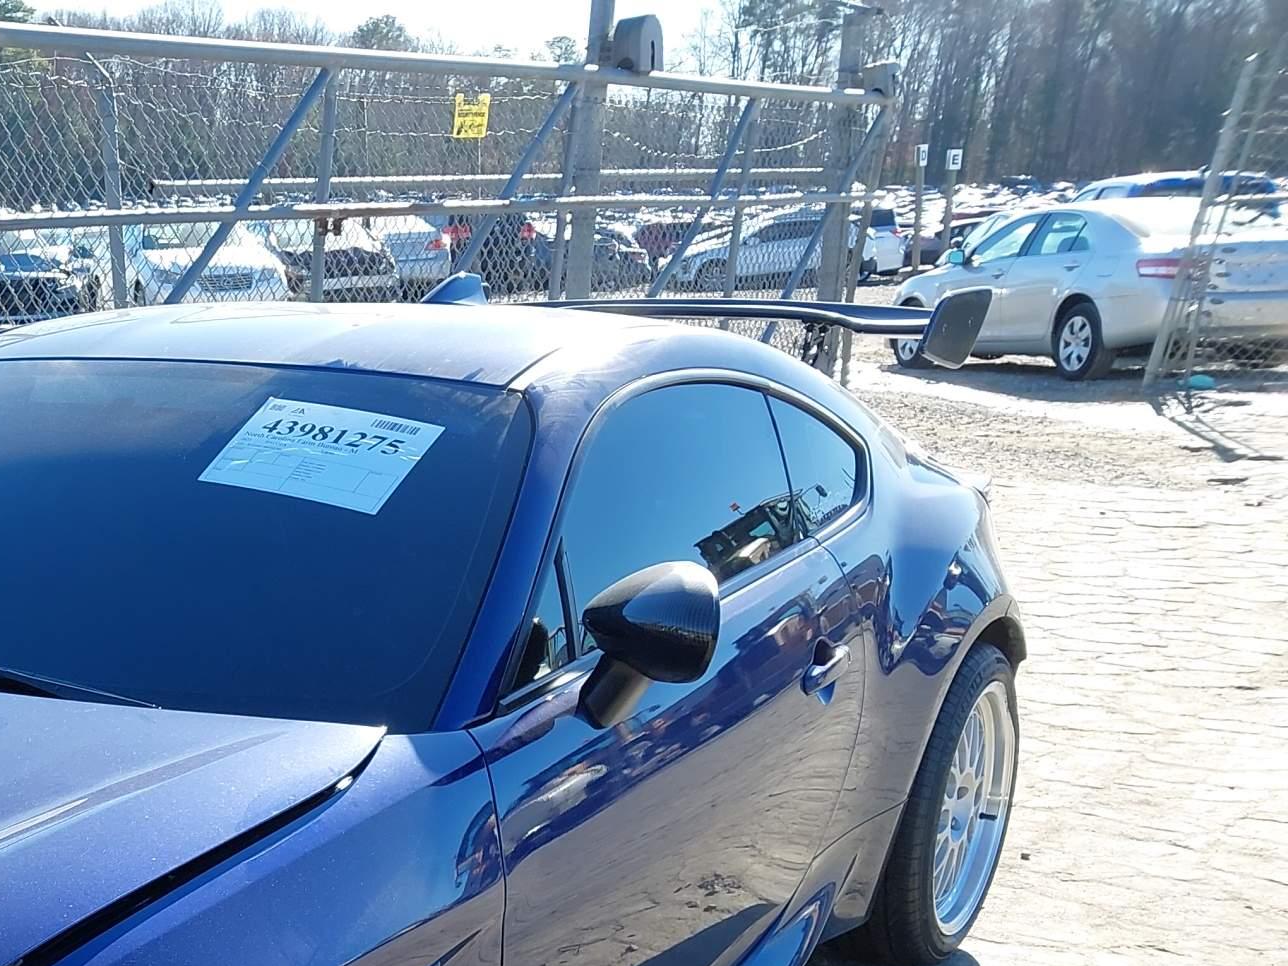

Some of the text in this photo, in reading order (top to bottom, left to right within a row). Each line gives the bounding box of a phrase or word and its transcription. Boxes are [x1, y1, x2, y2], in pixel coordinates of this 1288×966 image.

[921, 150, 926, 160] D
[952, 154, 960, 165] E
[262, 418, 406, 455] 43981275
